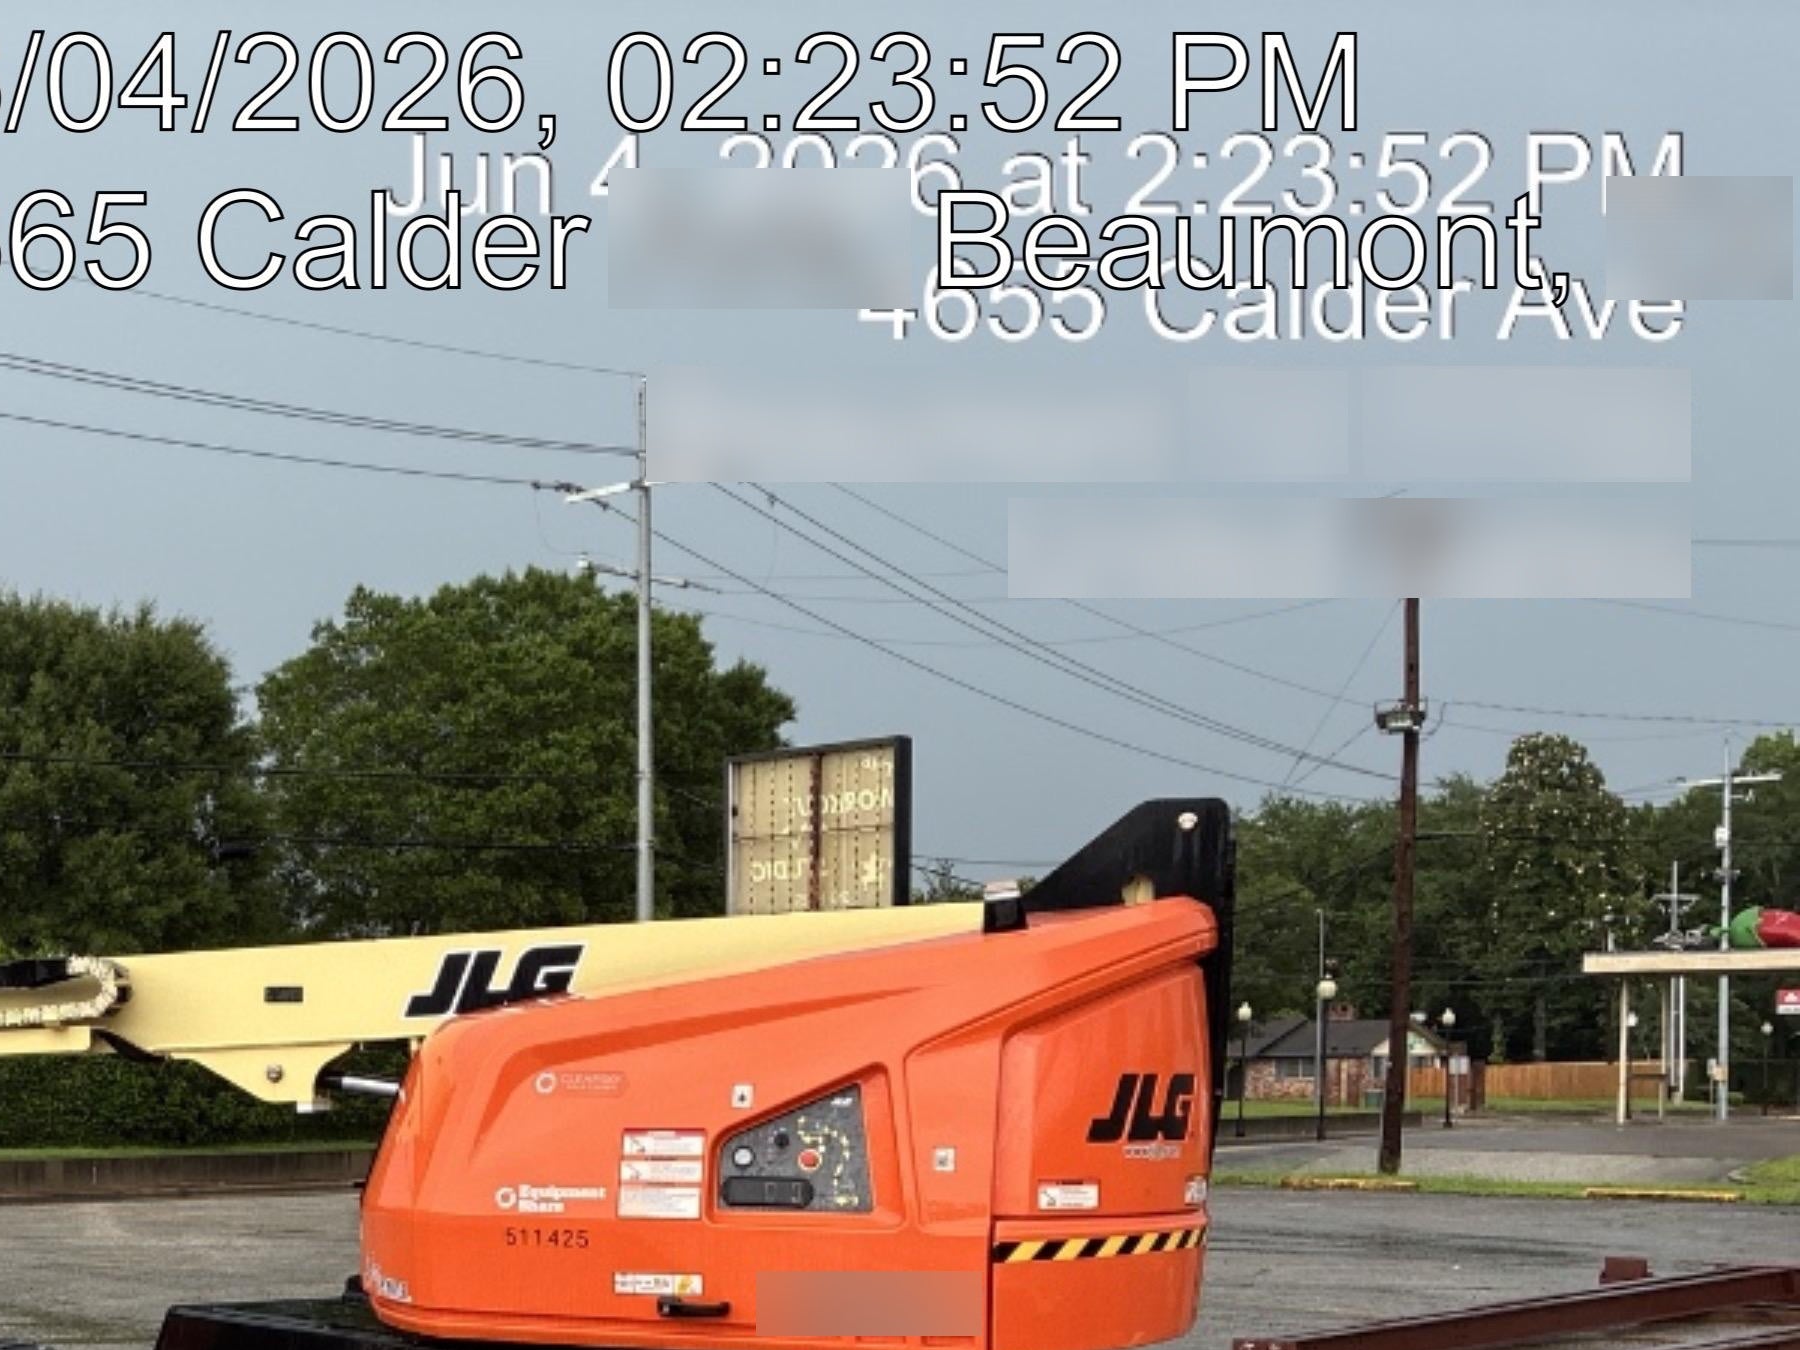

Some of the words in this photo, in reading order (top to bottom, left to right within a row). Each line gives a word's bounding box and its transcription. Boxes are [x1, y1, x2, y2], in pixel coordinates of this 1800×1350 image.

[404, 944, 585, 1017] JLG
[1086, 1073, 1196, 1143] JLG
[506, 1227, 589, 1248] 511425
